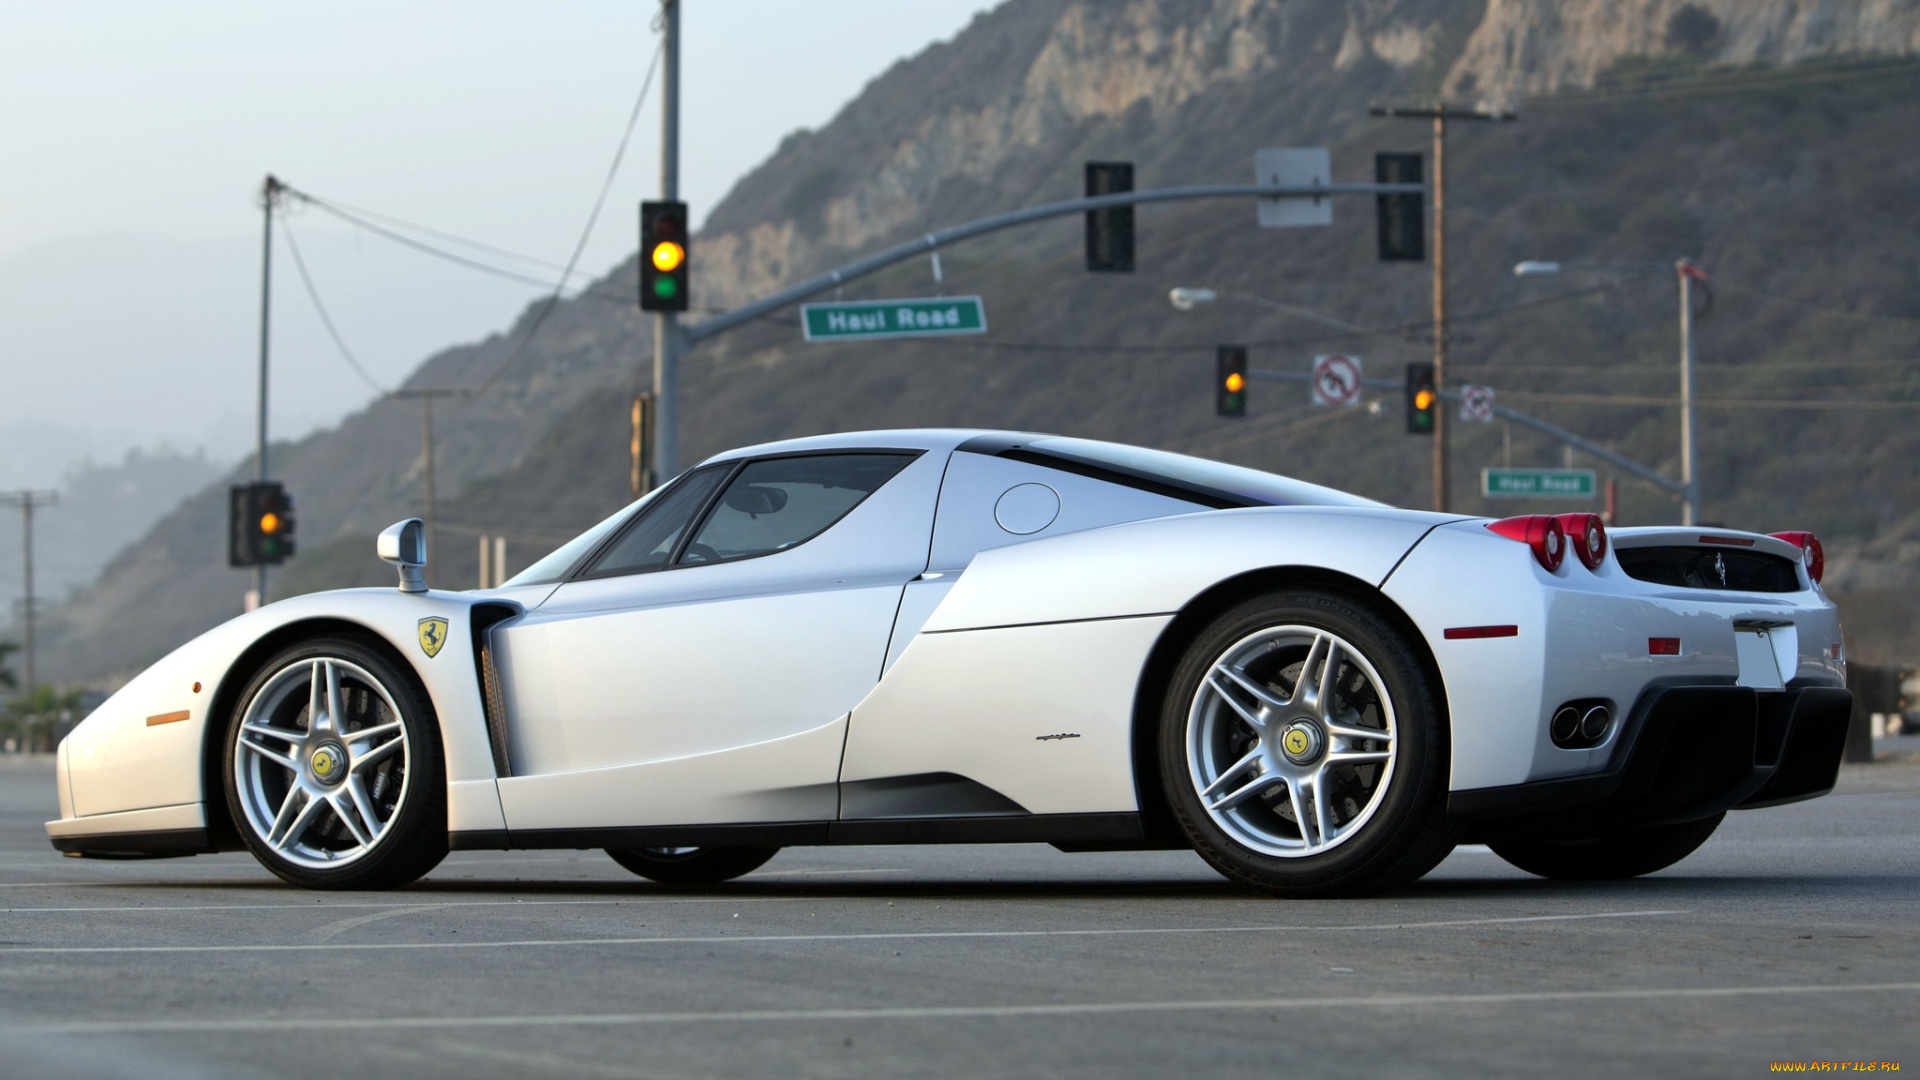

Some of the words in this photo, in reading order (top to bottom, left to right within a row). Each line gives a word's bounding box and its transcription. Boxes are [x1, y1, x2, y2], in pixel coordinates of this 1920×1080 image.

[827, 310, 885, 332] Haul
[897, 306, 960, 328] Road
[1541, 477, 1580, 491] Road
